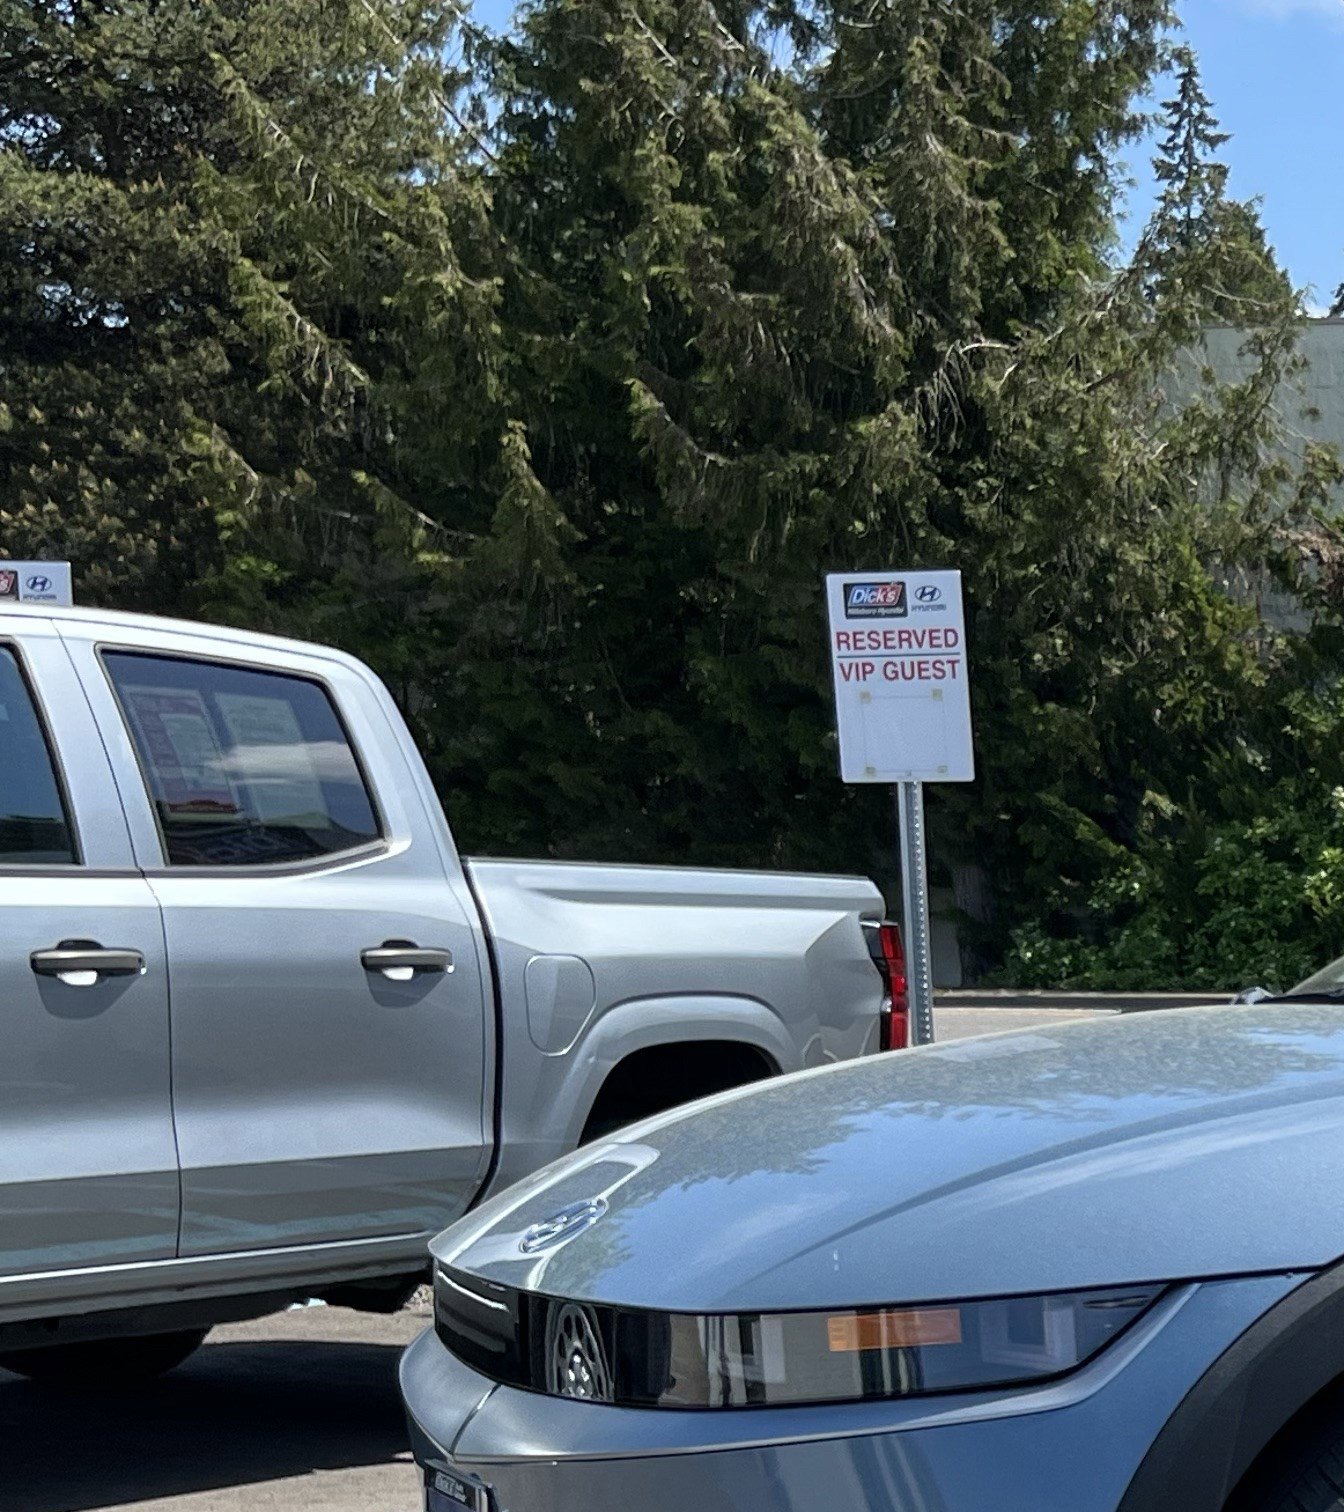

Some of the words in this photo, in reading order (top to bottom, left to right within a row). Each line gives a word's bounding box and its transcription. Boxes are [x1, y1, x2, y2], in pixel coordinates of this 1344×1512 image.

[852, 584, 898, 604] Dick's
[836, 628, 959, 651] RESERVED
[839, 662, 875, 682] VIP
[882, 660, 961, 681] GUEST
